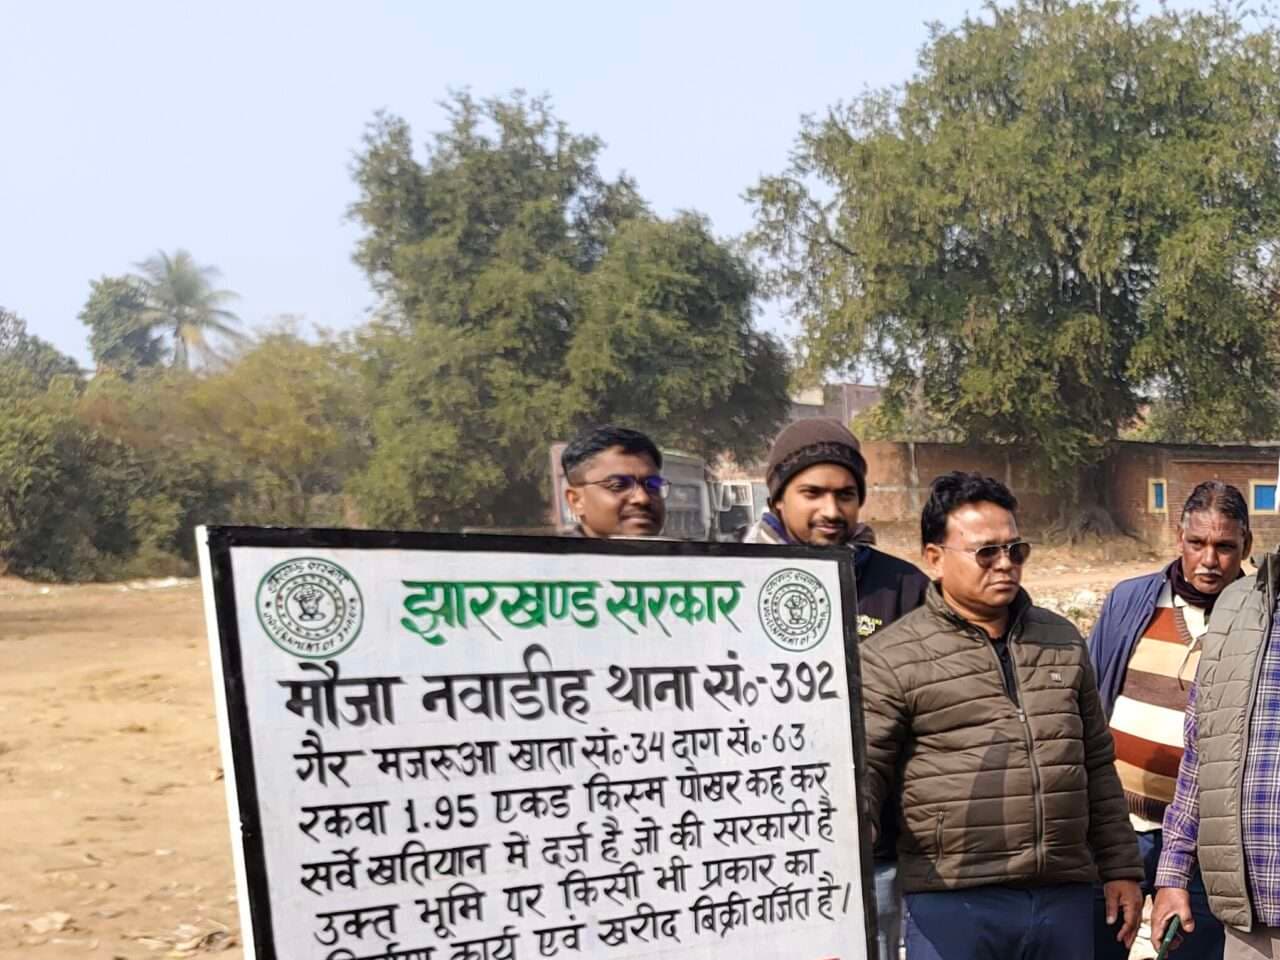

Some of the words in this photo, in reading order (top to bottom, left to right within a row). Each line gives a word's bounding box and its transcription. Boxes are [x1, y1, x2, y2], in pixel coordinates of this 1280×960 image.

[400, 579, 601, 645] झारखण्ड
[605, 579, 745, 638] सरकार
[277, 660, 405, 729] मौजा
[421, 643, 596, 724] नवाडीह
[606, 664, 699, 711] थाना
[293, 729, 367, 787] गैर
[509, 737, 577, 774] खाता
[672, 728, 723, 765] दाग
[299, 800, 390, 842] रकवा
[404, 793, 478, 833] 1.95
[582, 773, 668, 814] किस्म
[675, 766, 743, 804] पोखर
[745, 766, 785, 804] कह
[790, 762, 830, 796] कर
[300, 847, 361, 896] सर्वे
[367, 840, 492, 886] खतियान
[503, 831, 529, 869] में
[541, 821, 593, 869] दर्ज
[600, 815, 623, 864] है
[632, 817, 663, 856] जो
[670, 809, 705, 850] की
[713, 798, 815, 846] सरकारी
[817, 795, 837, 842] है
[313, 903, 400, 945] उक्त
[415, 882, 487, 939] भूमि
[502, 884, 546, 918] पर
[557, 861, 645, 910] किसी
[653, 855, 693, 892] भी
[699, 854, 778, 890] प्रकार
[784, 848, 820, 876] का
[533, 914, 587, 957] एवं
[598, 902, 682, 946] खरीद
[688, 891, 752, 938] बिक्री
[752, 882, 813, 923] वर्जित
